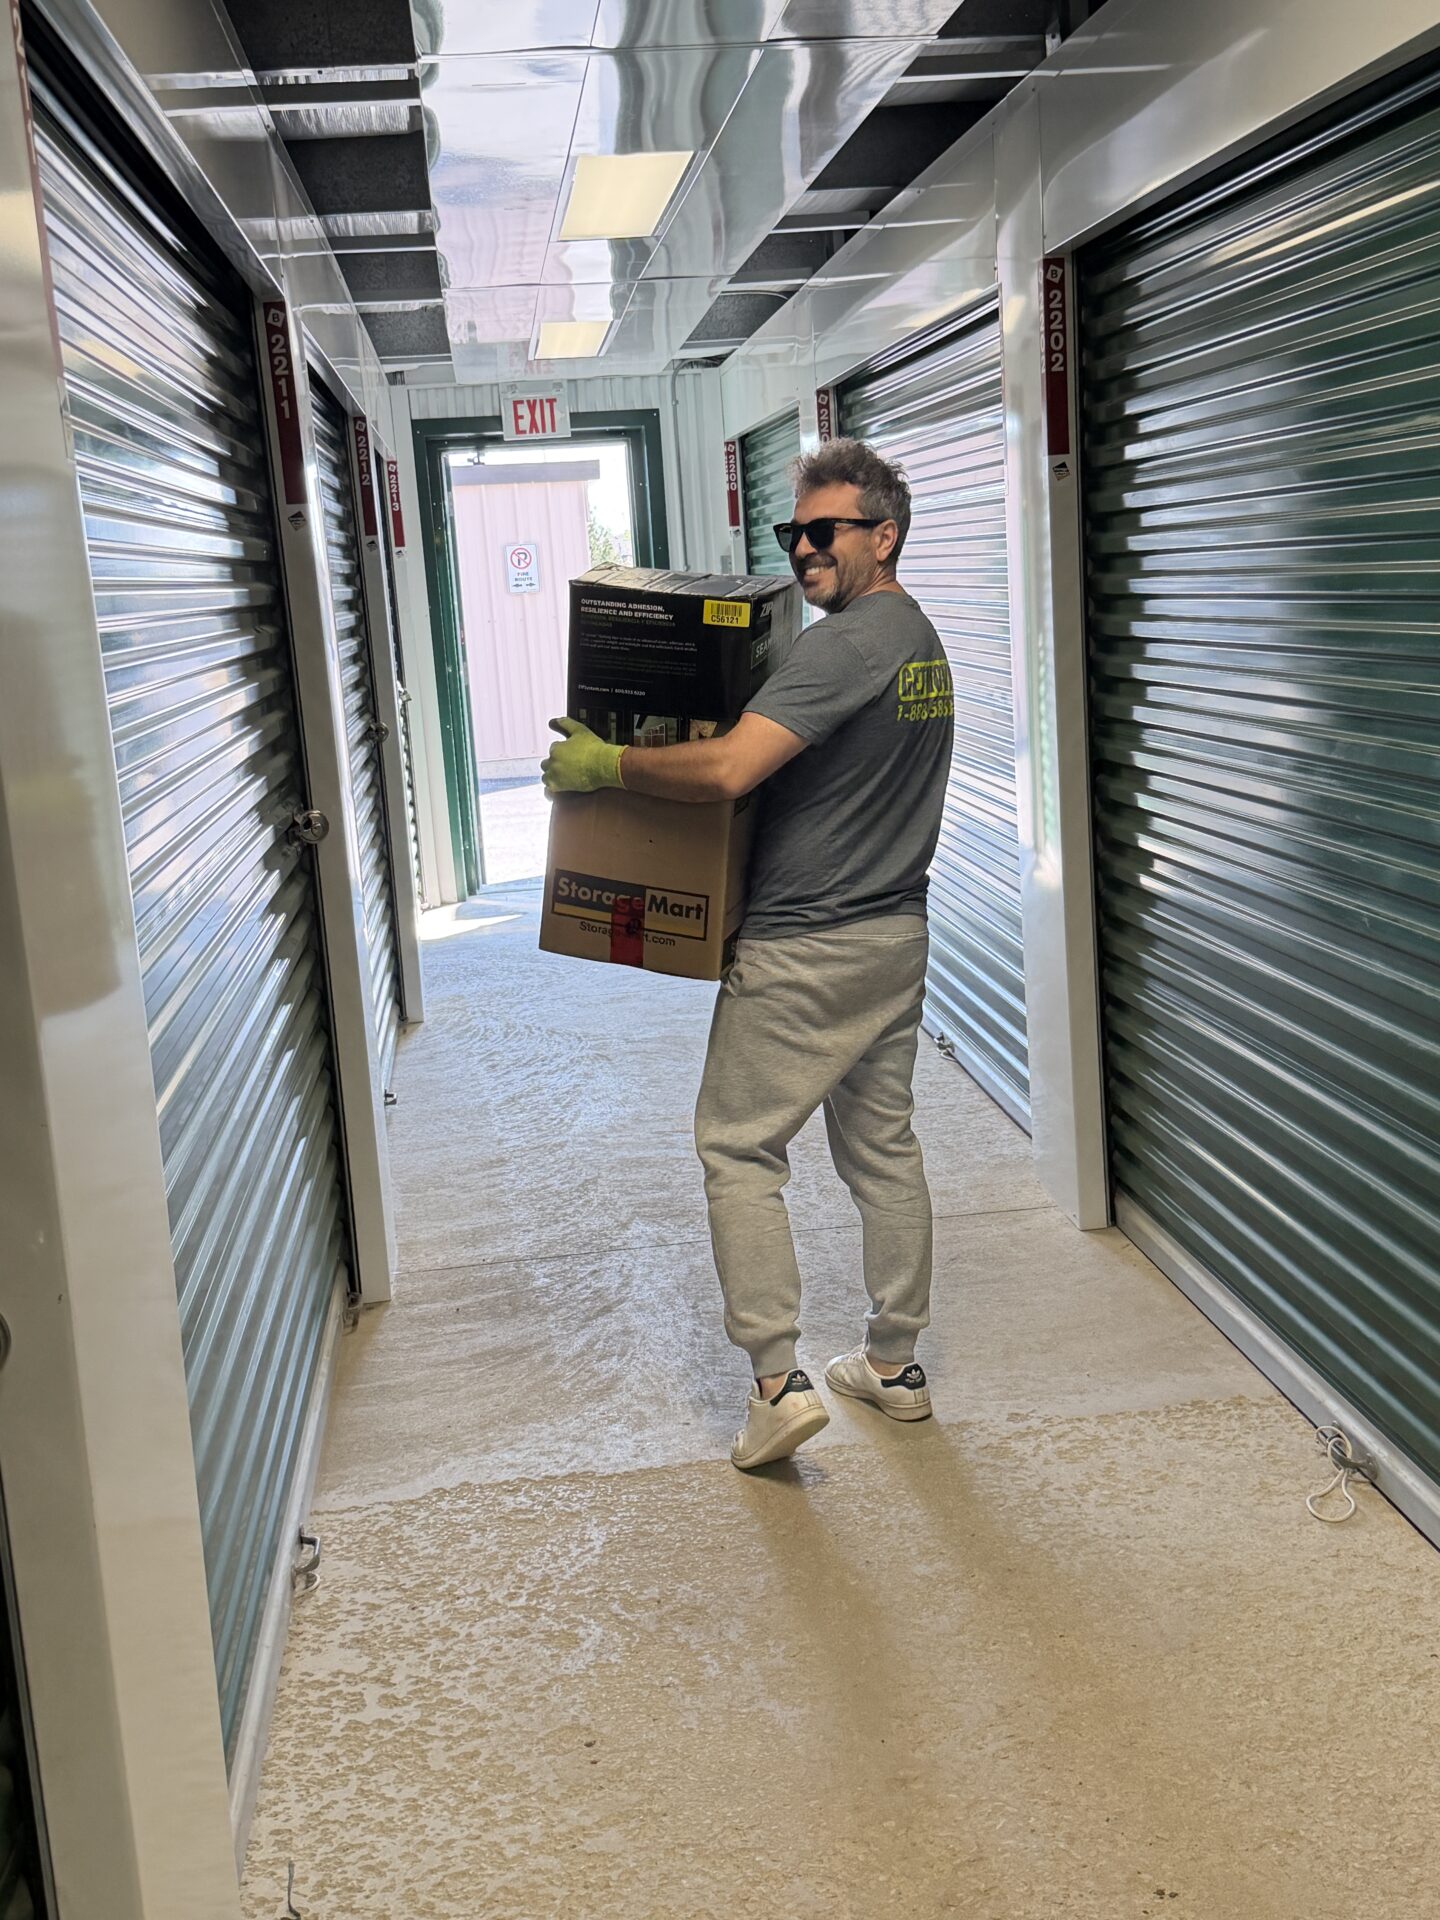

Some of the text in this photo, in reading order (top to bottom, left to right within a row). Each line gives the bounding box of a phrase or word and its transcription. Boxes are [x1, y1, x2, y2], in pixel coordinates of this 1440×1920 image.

[1049, 289, 1064, 372] 2202
[270, 334, 290, 419] 2211
[512, 398, 558, 435] EXIT
[357, 435, 371, 486] 2212
[728, 455, 738, 491] 2200
[389, 474, 400, 512] 2213
[580, 607, 617, 616] RESILIENCE
[634, 612, 674, 621] EFFICIENCY
[581, 598, 665, 613] OUTSTANDING ADHESION,
[710, 614, 739, 625] C56121
[557, 876, 704, 920] Storage Mart
